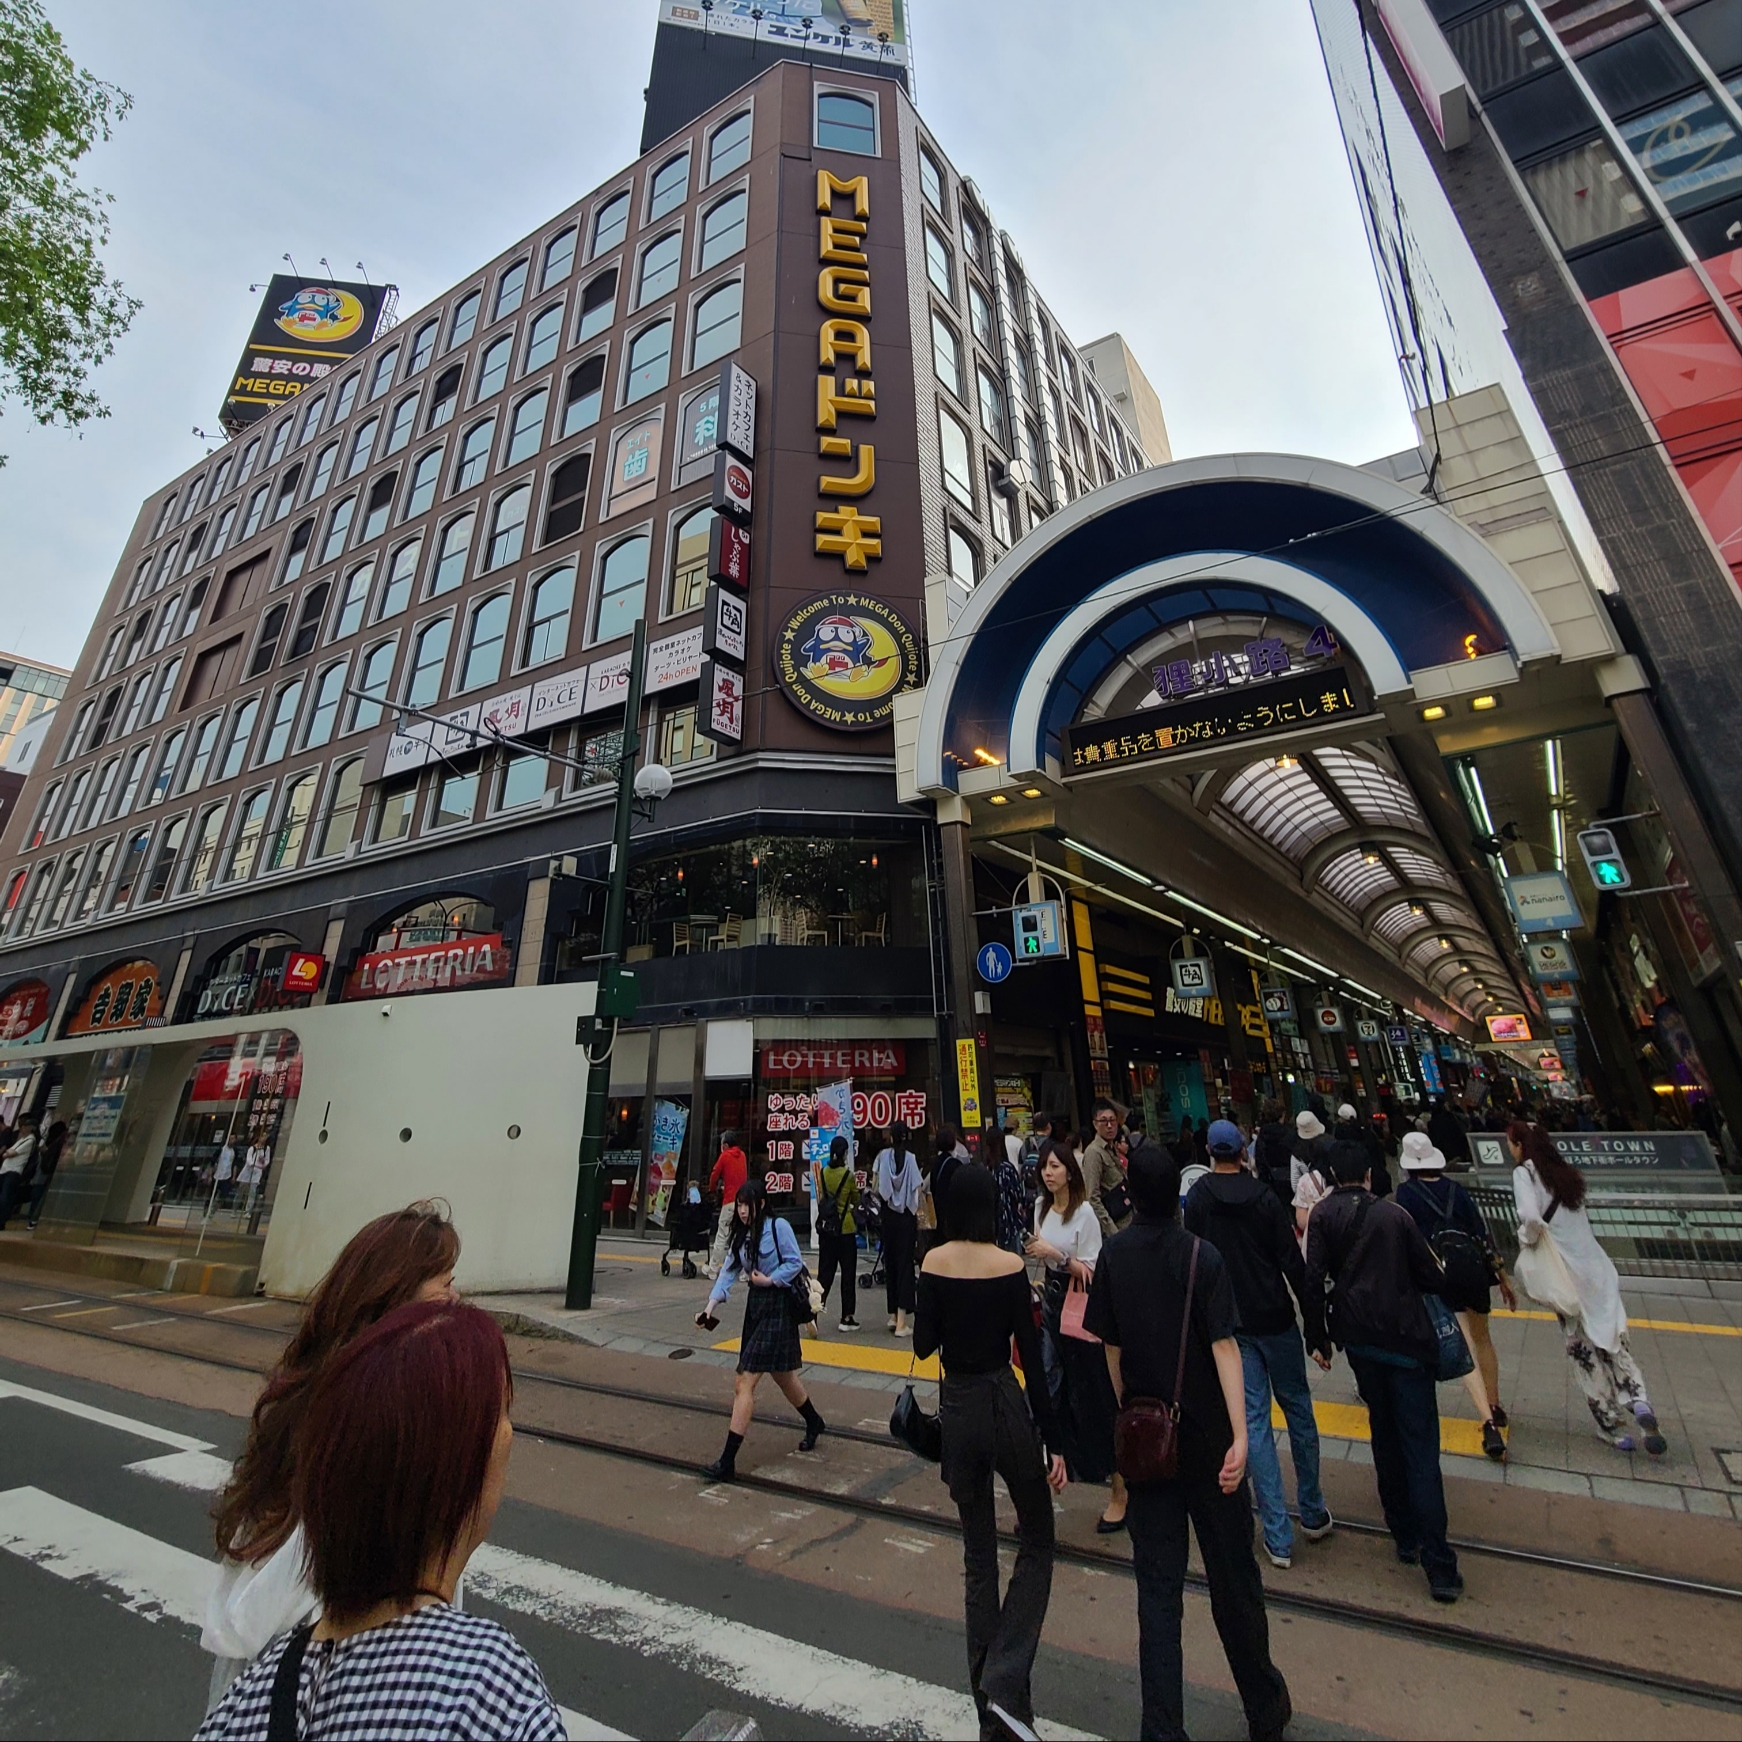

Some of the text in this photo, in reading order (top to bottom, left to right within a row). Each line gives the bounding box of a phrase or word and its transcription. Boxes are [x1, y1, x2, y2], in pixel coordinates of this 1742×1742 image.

[767, 24, 855, 48] ユンケル
[250, 356, 336, 378] 驚安の殿
[234, 375, 306, 396] MEGA
[743, 379, 754, 443] ネットカフェ
[626, 430, 651, 450] エイト
[623, 446, 649, 482] 歯
[729, 475, 749, 493] ガスト
[728, 526, 742, 579] しゃぶ葉
[830, 595, 845, 605] To
[860, 597, 889, 618] MEGA
[788, 599, 830, 630] Welcome
[888, 615, 906, 634] Don
[668, 645, 692, 659] カラオケ
[780, 643, 798, 682] Quijote
[901, 633, 919, 671] Quijote
[1152, 625, 1339, 697] 狸小路 4
[599, 667, 629, 692] DiC
[675, 664, 698, 678] OPEN
[535, 685, 579, 712] DiCE
[792, 683, 811, 704] Don
[810, 699, 841, 721] MEGA
[361, 943, 494, 990] LOTTERIA
[90, 976, 154, 1027] 吉野家
[768, 1048, 898, 1070] LOTTERIA
[959, 1043, 970, 1093] 通行禁止
[851, 1090, 927, 1130] 90席
[766, 1112, 811, 1132] 座れる
[766, 1140, 794, 1162] 1階
[810, 1142, 831, 1156] チュロ
[1557, 1140, 1656, 1151] OLE TOWN
[1564, 1154, 1659, 1165] ぽろ地下街ポールタウン
[765, 1172, 794, 1194] 2階
